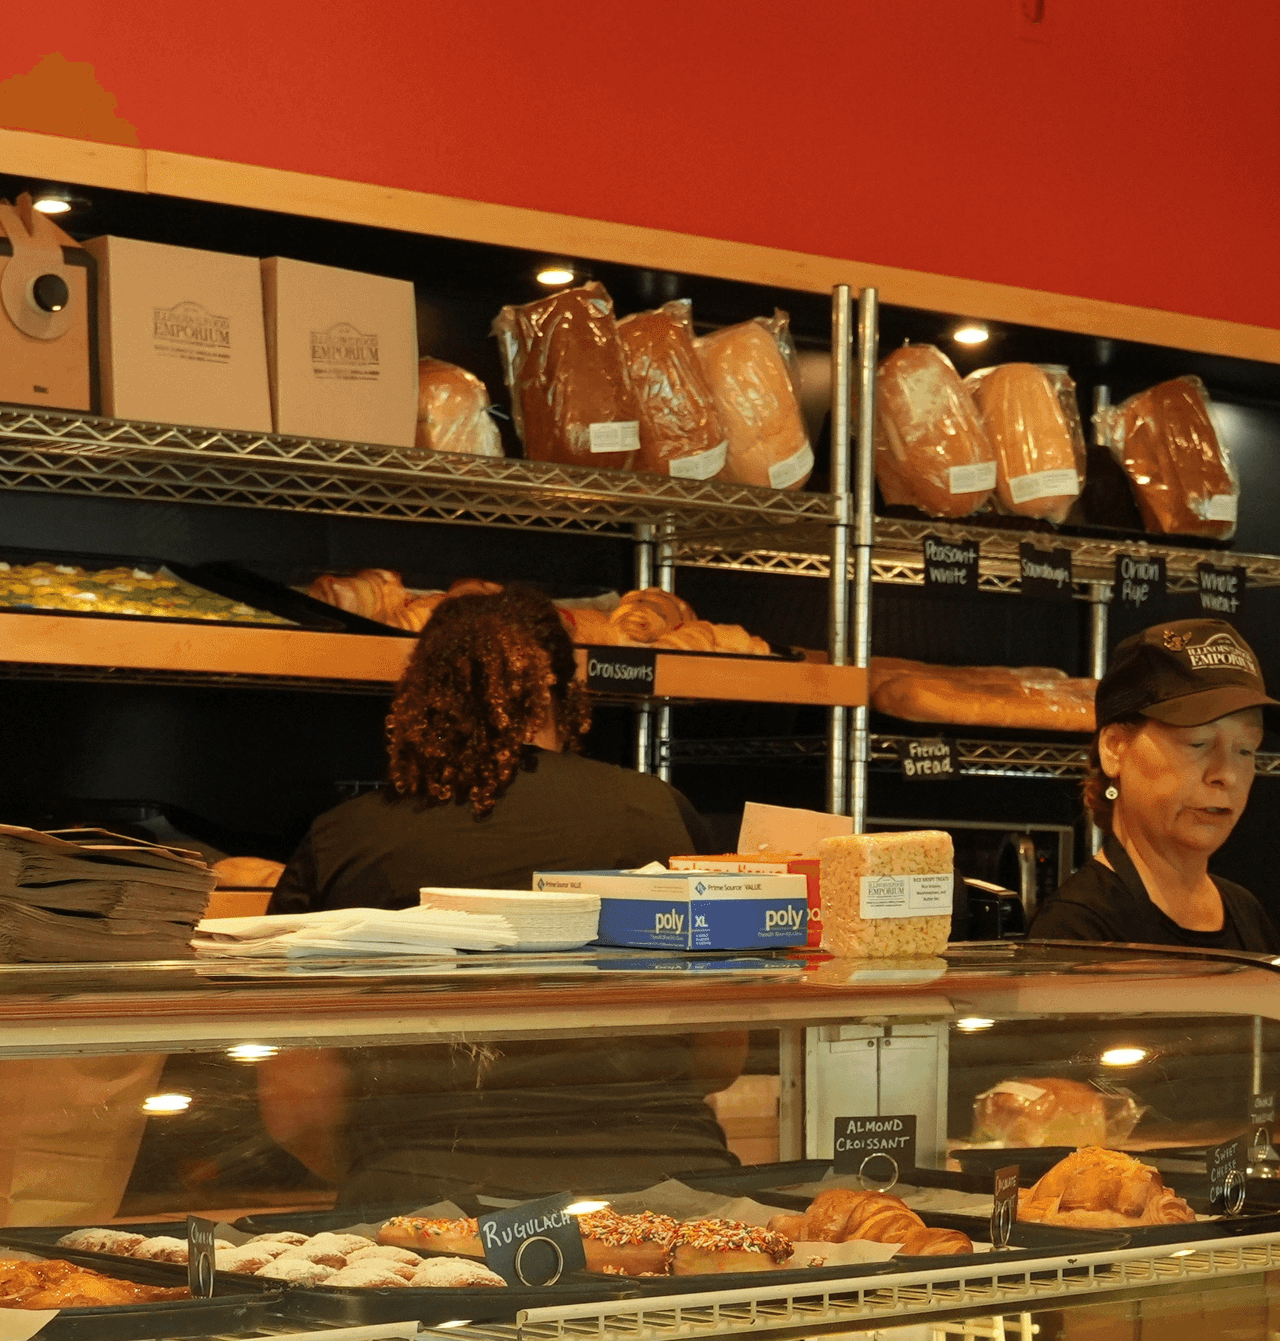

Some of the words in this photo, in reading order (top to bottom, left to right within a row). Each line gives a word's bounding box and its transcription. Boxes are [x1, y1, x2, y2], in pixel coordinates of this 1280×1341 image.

[925, 540, 977, 564] Peasant
[929, 567, 968, 586] White
[1121, 558, 1159, 581] Onion
[1200, 571, 1238, 593] Whole
[1122, 581, 1149, 608] Rye
[1201, 592, 1241, 613] Wheat
[588, 658, 654, 682] Croissants
[909, 742, 950, 757] French
[903, 757, 954, 776] Bread
[655, 908, 684, 934] poly
[695, 915, 709, 927] XL
[765, 904, 803, 931] poly
[846, 1119, 904, 1135] ALMOND
[836, 1137, 910, 1151] CROISSANT
[1214, 1142, 1238, 1164] SWEET
[482, 1212, 571, 1249] RUGULACH
